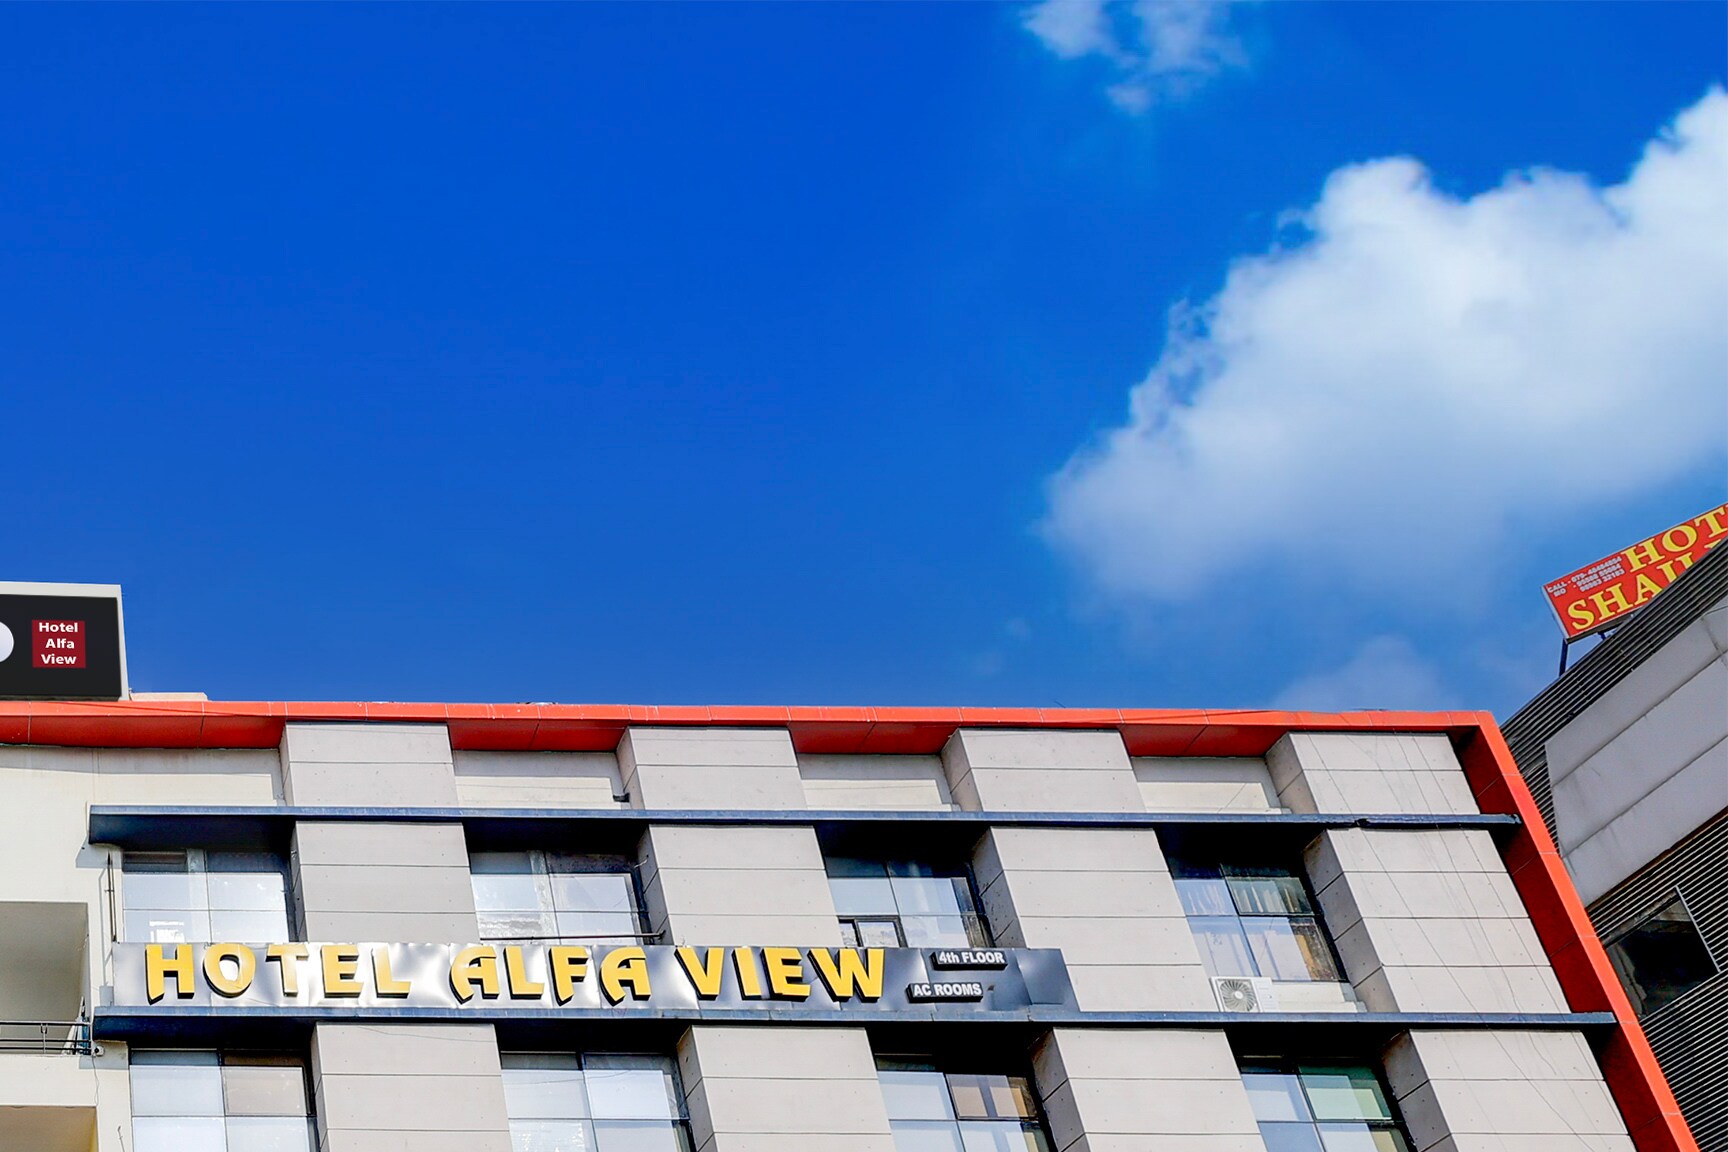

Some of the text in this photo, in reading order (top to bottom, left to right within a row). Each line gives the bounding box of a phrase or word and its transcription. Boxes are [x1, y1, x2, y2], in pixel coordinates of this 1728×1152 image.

[39, 623, 78, 632] Hotel
[46, 639, 74, 648] Alfa
[41, 654, 76, 664] View
[938, 951, 1005, 964] 4th FLOOR
[145, 944, 885, 1006] HOTEL ALFA VIEW
[913, 984, 982, 997] AC ROOMS
